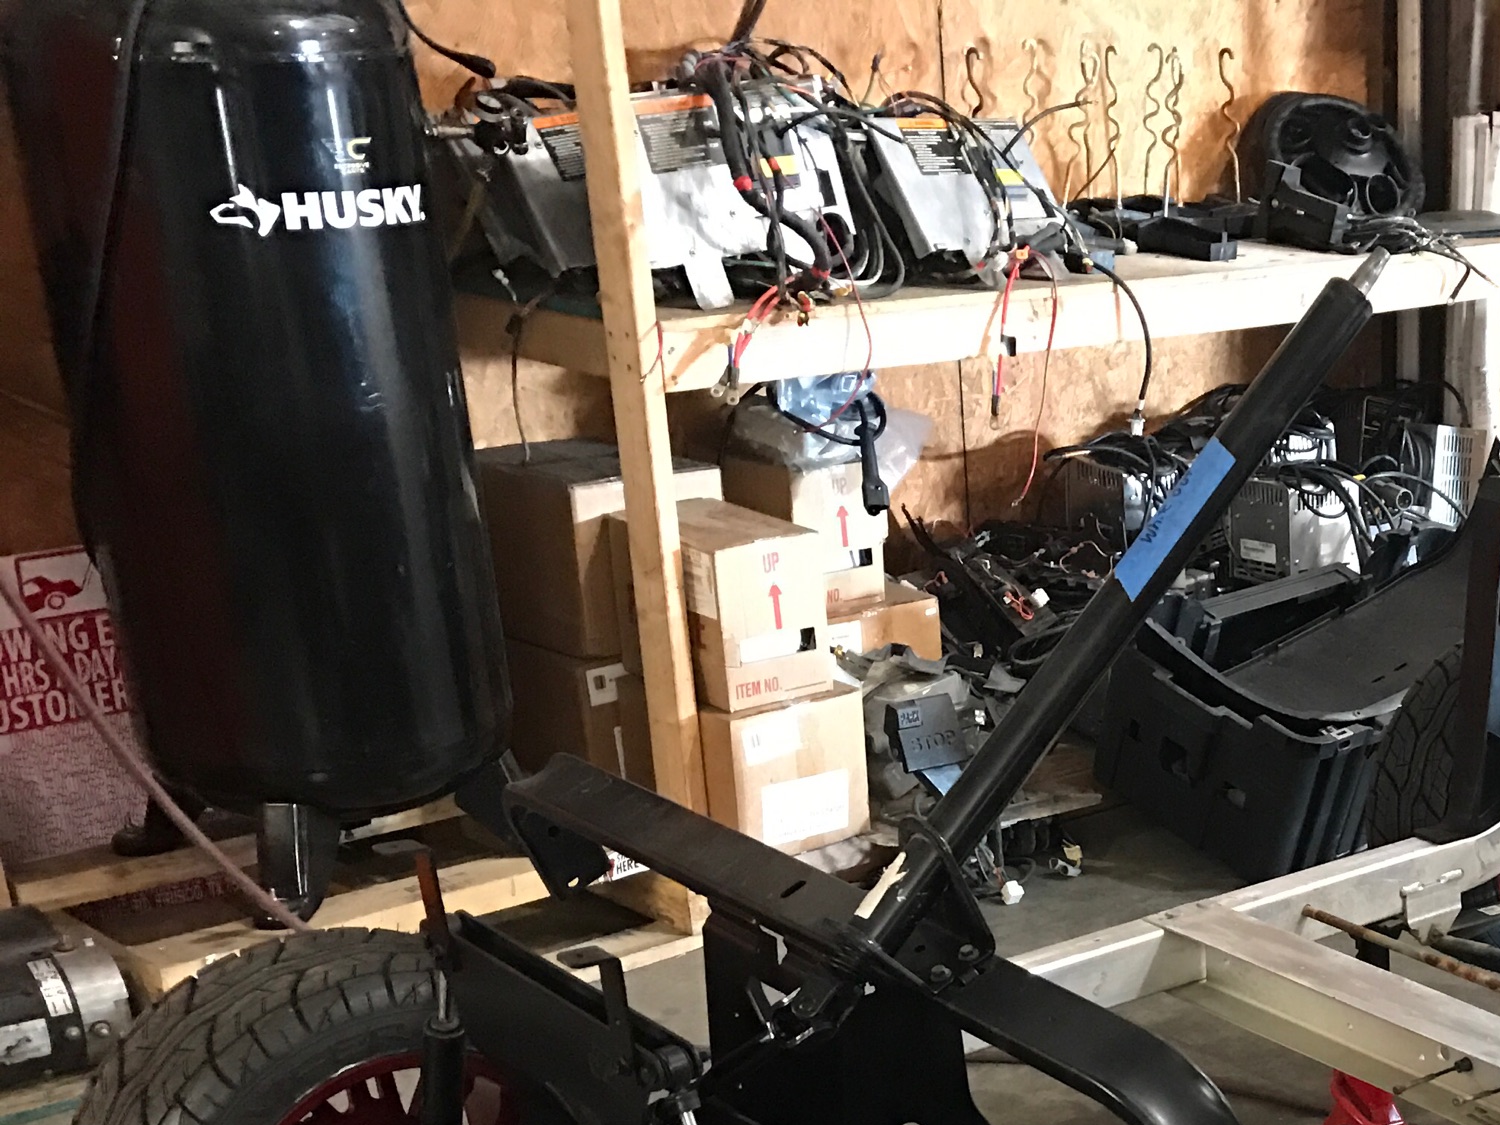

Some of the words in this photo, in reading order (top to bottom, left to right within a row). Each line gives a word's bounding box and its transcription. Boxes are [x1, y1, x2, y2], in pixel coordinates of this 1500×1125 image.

[831, 476, 848, 495] UP
[762, 551, 780, 574] UP
[2, 658, 50, 697] HRS
[735, 681, 762, 700] ITEM
[764, 676, 782, 693] NO.
[911, 729, 956, 752] STOP
